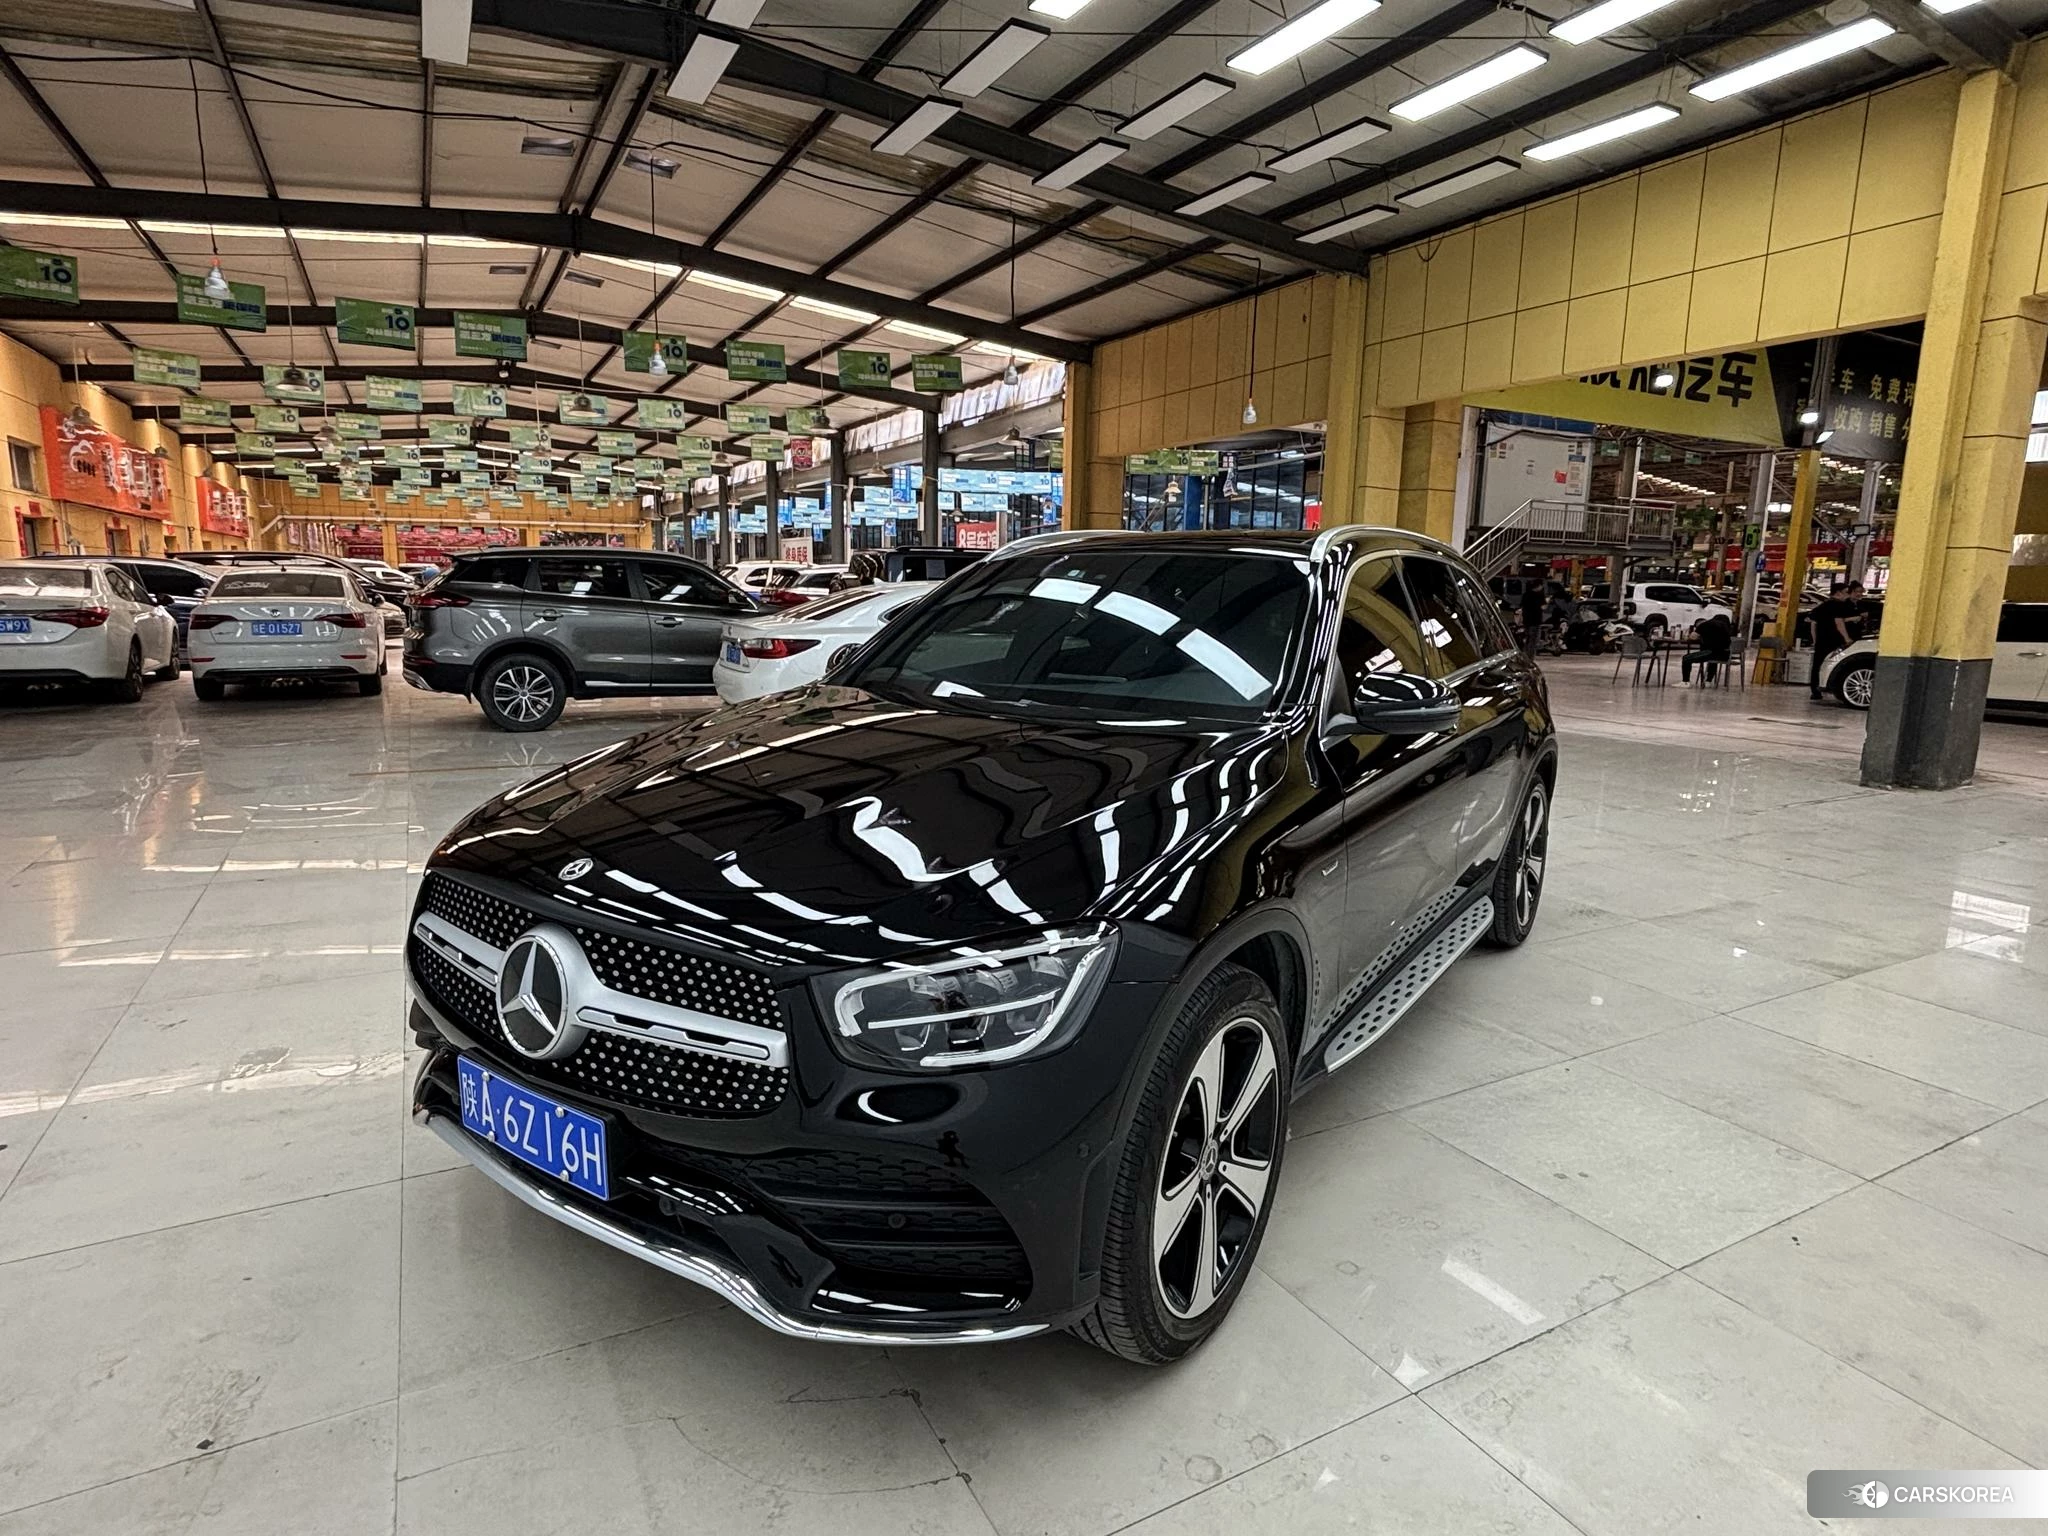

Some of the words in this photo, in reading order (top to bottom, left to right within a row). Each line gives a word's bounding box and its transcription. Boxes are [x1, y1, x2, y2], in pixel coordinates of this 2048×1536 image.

[40, 265, 72, 284] 10
[385, 314, 410, 331] 10
[662, 345, 684, 359] 10
[870, 362, 888, 374] 10
[486, 394, 503, 406] 10
[281, 413, 296, 423] 10
[667, 408, 682, 418] 10
[455, 428, 468, 436] 10
[260, 440, 273, 448] 10
[699, 442, 710, 450] 10
[407, 452, 418, 460] 10
